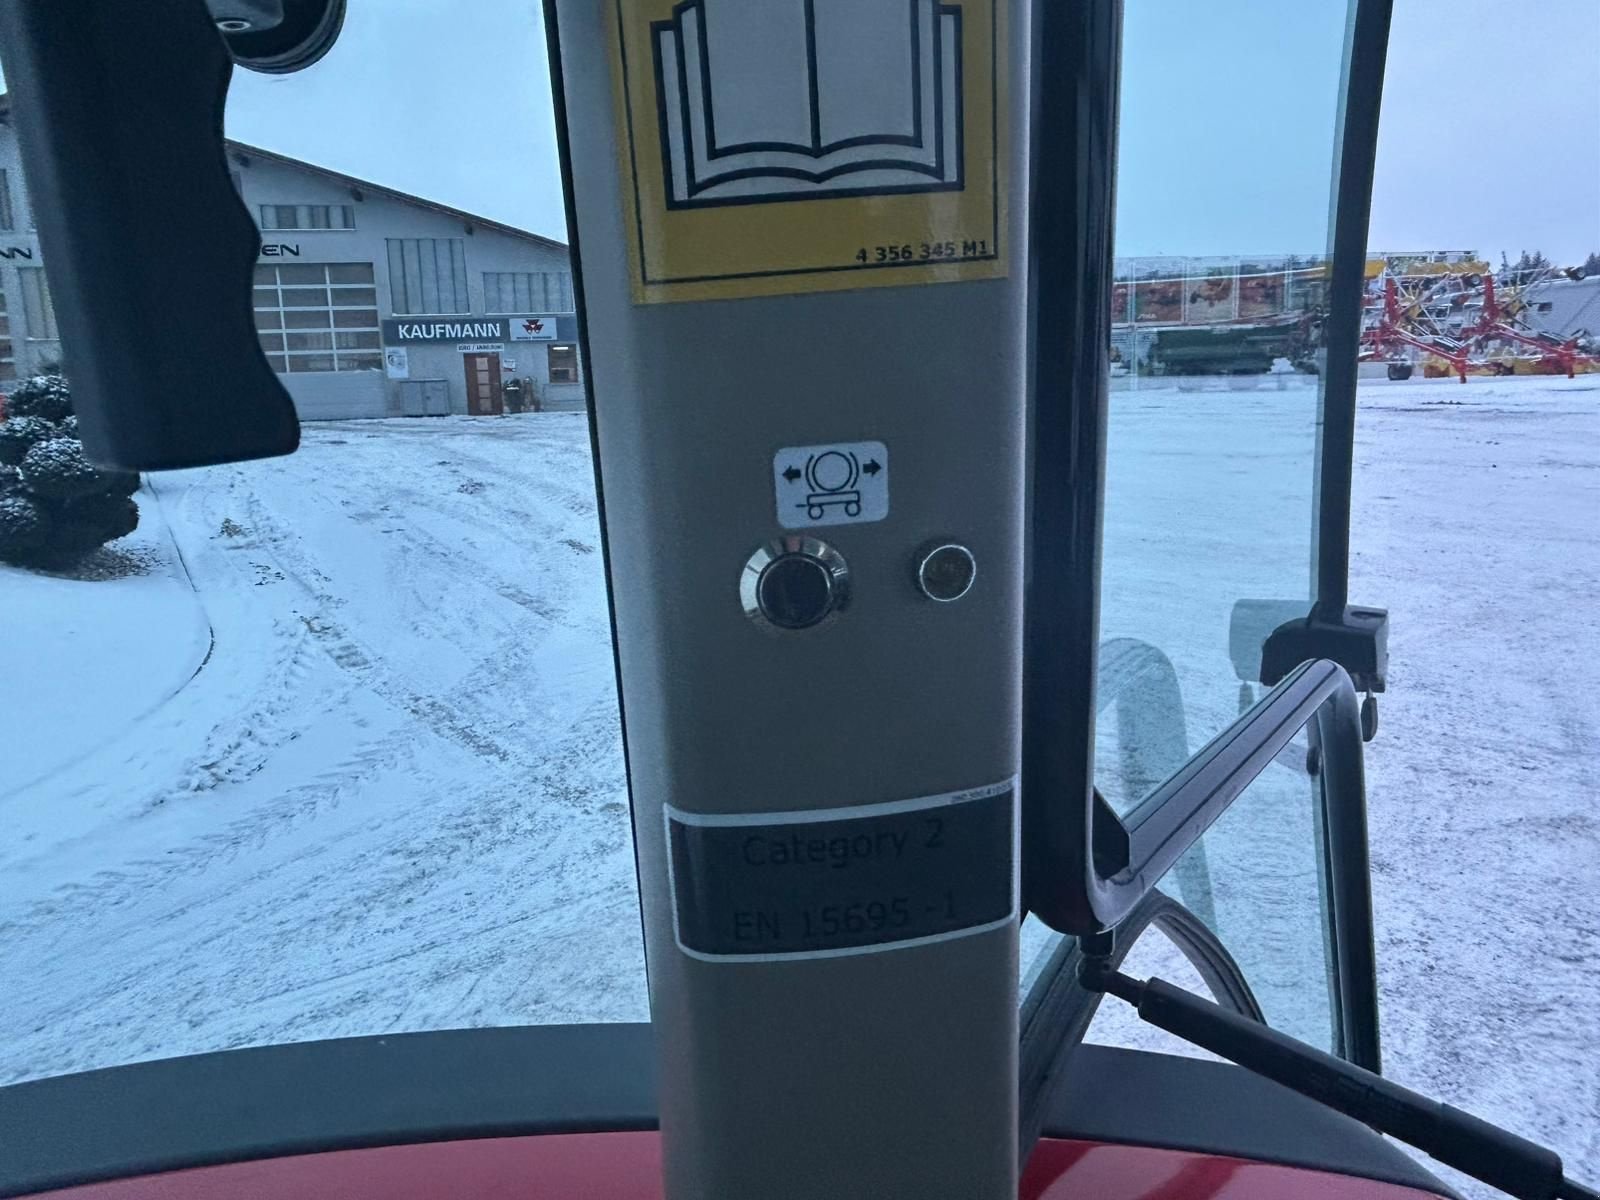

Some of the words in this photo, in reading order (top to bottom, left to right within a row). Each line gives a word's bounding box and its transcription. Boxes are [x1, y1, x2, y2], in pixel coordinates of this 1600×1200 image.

[258, 244, 299, 256] EN
[856, 247, 867, 263] 4
[875, 244, 912, 262] 356
[920, 240, 955, 259] 345
[963, 239, 986, 256] M1
[398, 323, 501, 339] KAUFMANN
[742, 829, 908, 868] Category
[924, 818, 944, 848] 2
[733, 911, 780, 942] EN
[803, 896, 909, 937] 15695
